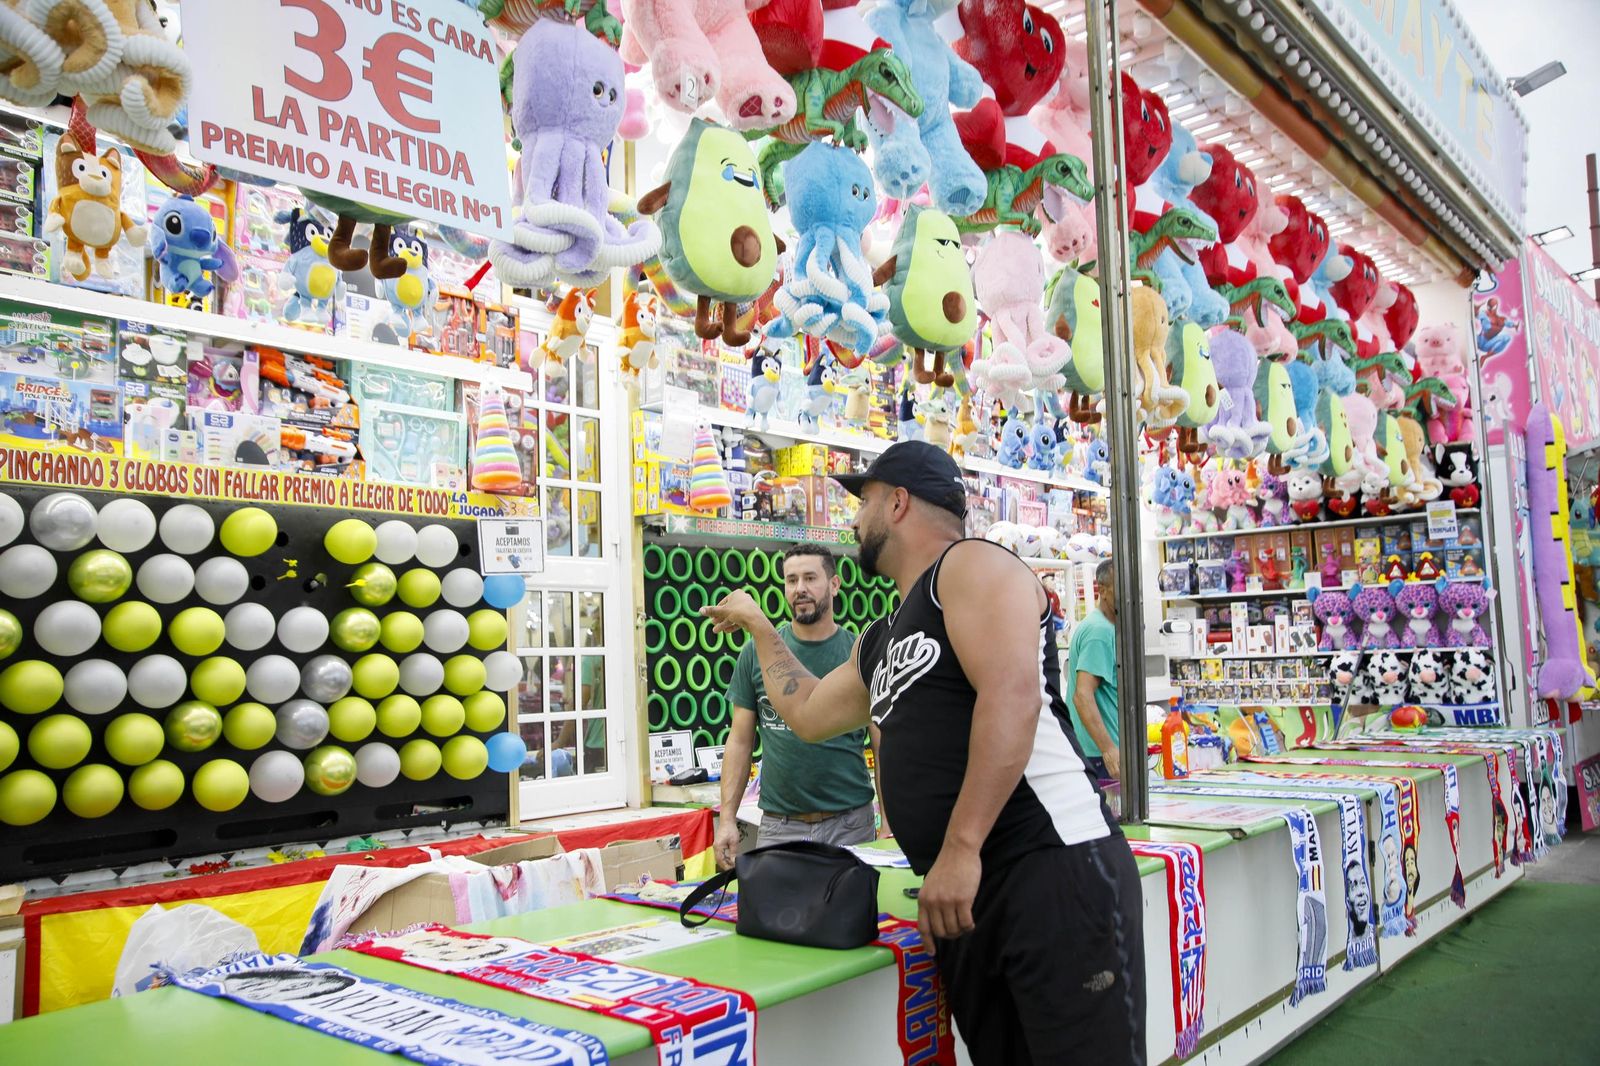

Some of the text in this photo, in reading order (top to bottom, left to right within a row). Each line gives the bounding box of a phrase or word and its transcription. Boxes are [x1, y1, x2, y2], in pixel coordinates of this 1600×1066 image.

[391, 1, 422, 32] ES
[428, 17, 495, 64] CARA
[252, 85, 475, 186] LA PARTIDA
[201, 120, 330, 179] PREMIO
[337, 160, 359, 189] A
[364, 166, 457, 216] ELEGIR
[0, 448, 449, 516] PINCHANDO 3 GLOBOS SIN FALLAR PREMIO A ELEGIR DE TODO
[452, 492, 468, 504] LA
[459, 504, 505, 517] JUGADA
[495, 537, 531, 547] ACEPTAMOS
[654, 747, 683, 759] ACEPTAMOS
